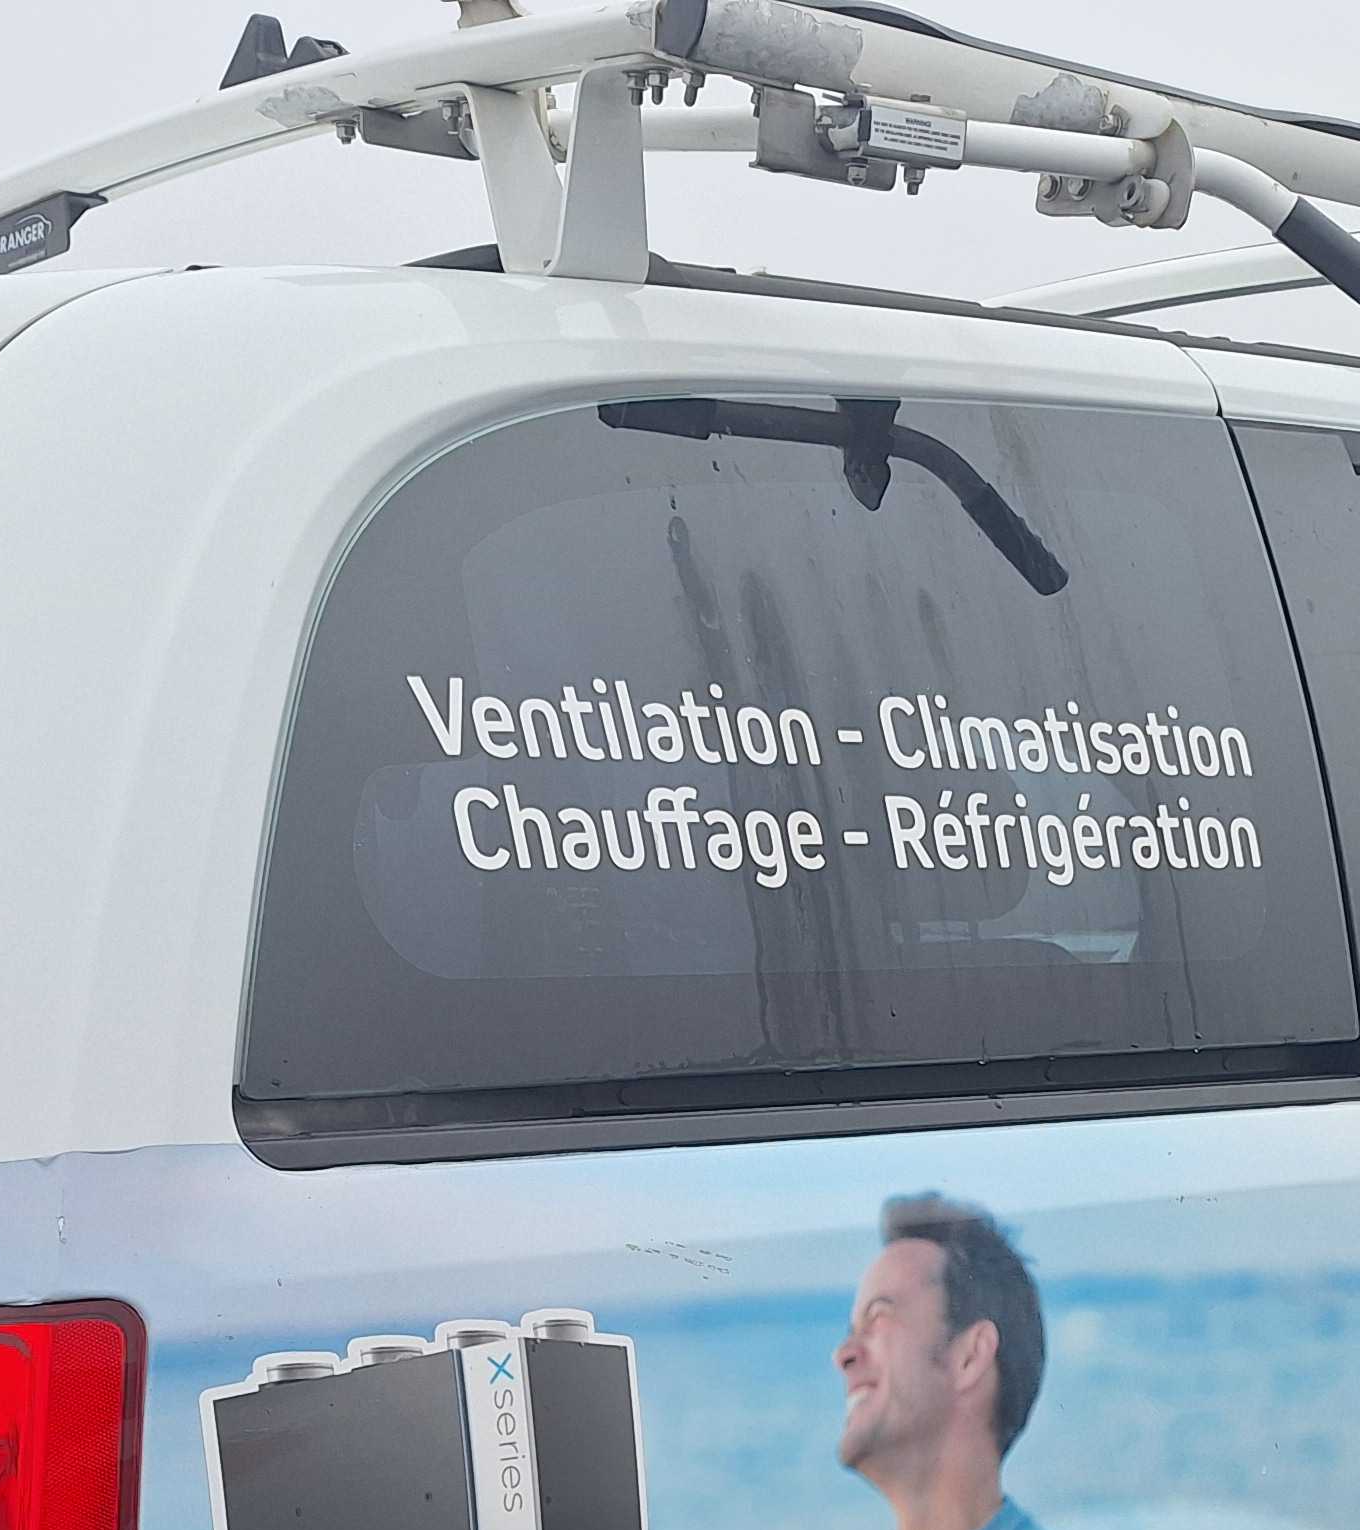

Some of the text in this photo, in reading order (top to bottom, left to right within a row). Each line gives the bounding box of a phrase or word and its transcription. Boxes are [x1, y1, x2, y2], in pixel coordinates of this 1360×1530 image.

[0, 221, 45, 254] RANGER
[406, 675, 1254, 777] Ventilation - Climatisation
[453, 784, 1262, 889] Chauffage - Réfrigération
